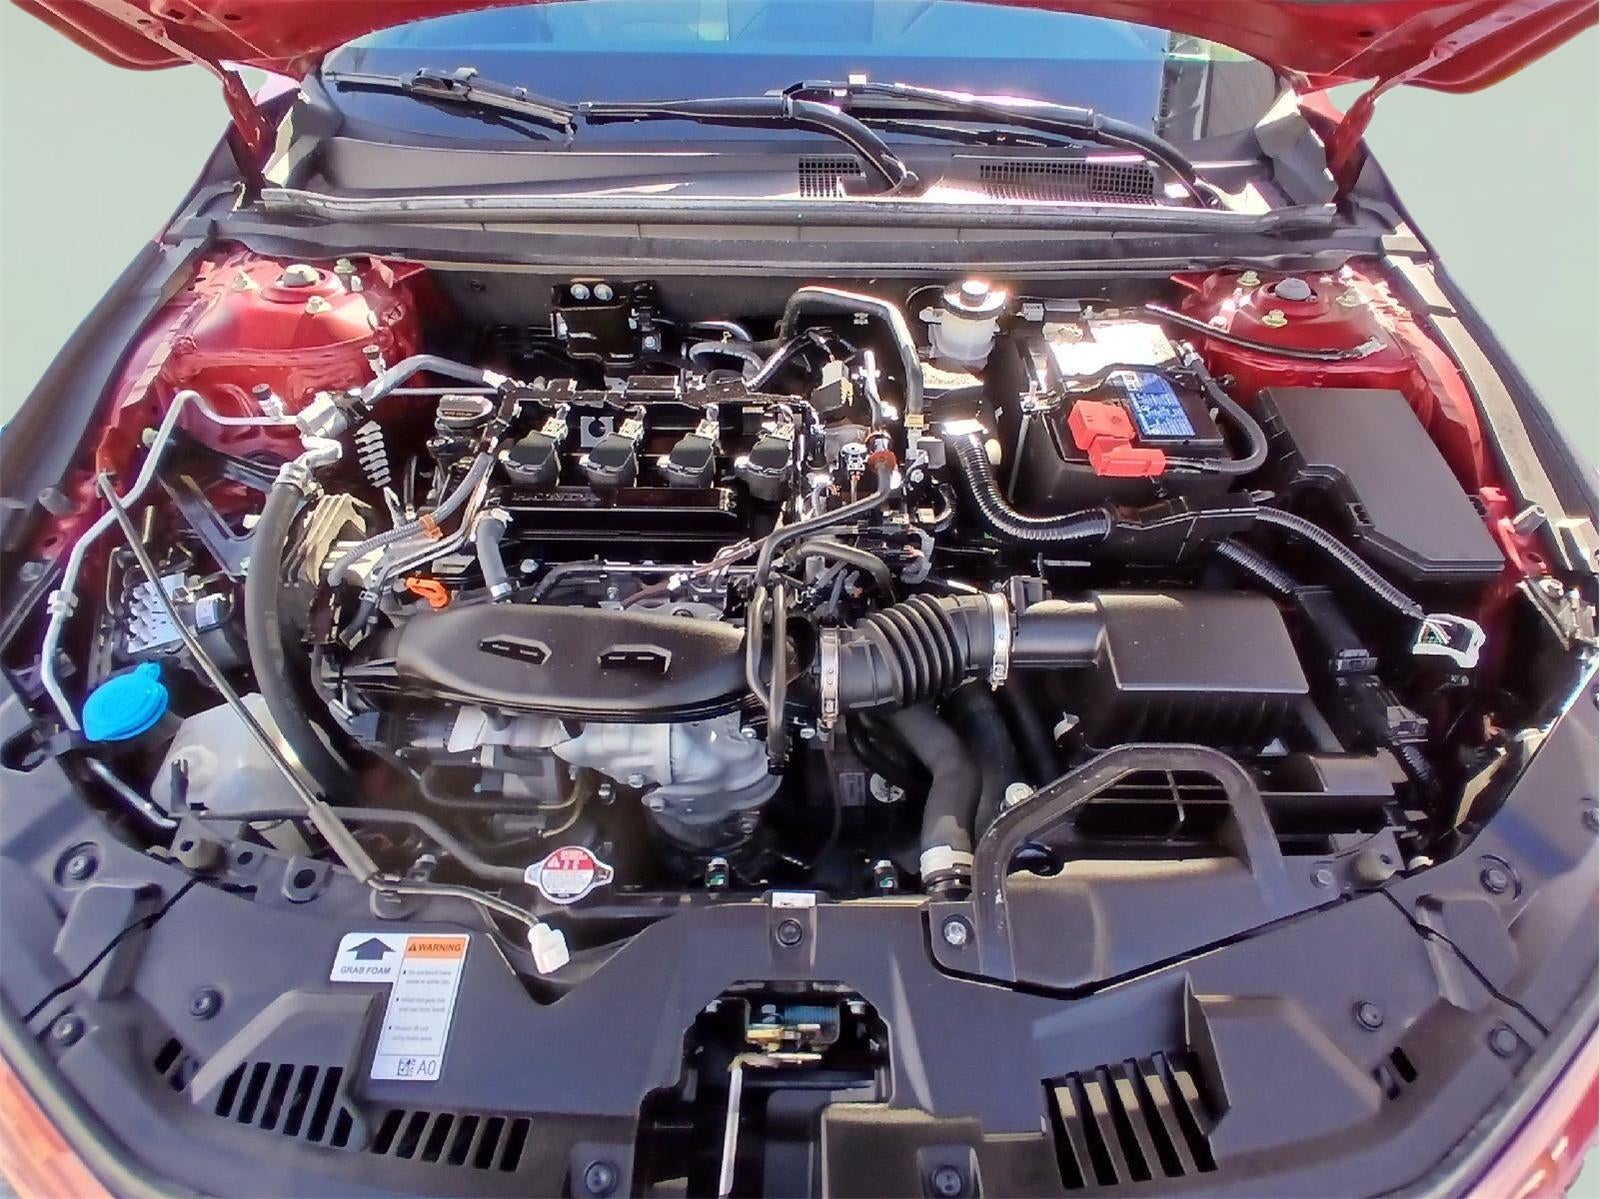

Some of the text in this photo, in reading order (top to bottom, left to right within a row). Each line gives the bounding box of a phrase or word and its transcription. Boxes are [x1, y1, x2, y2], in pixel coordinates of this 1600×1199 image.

[418, 943, 461, 952] WARNING
[340, 966, 391, 975] GRAB FOAM
